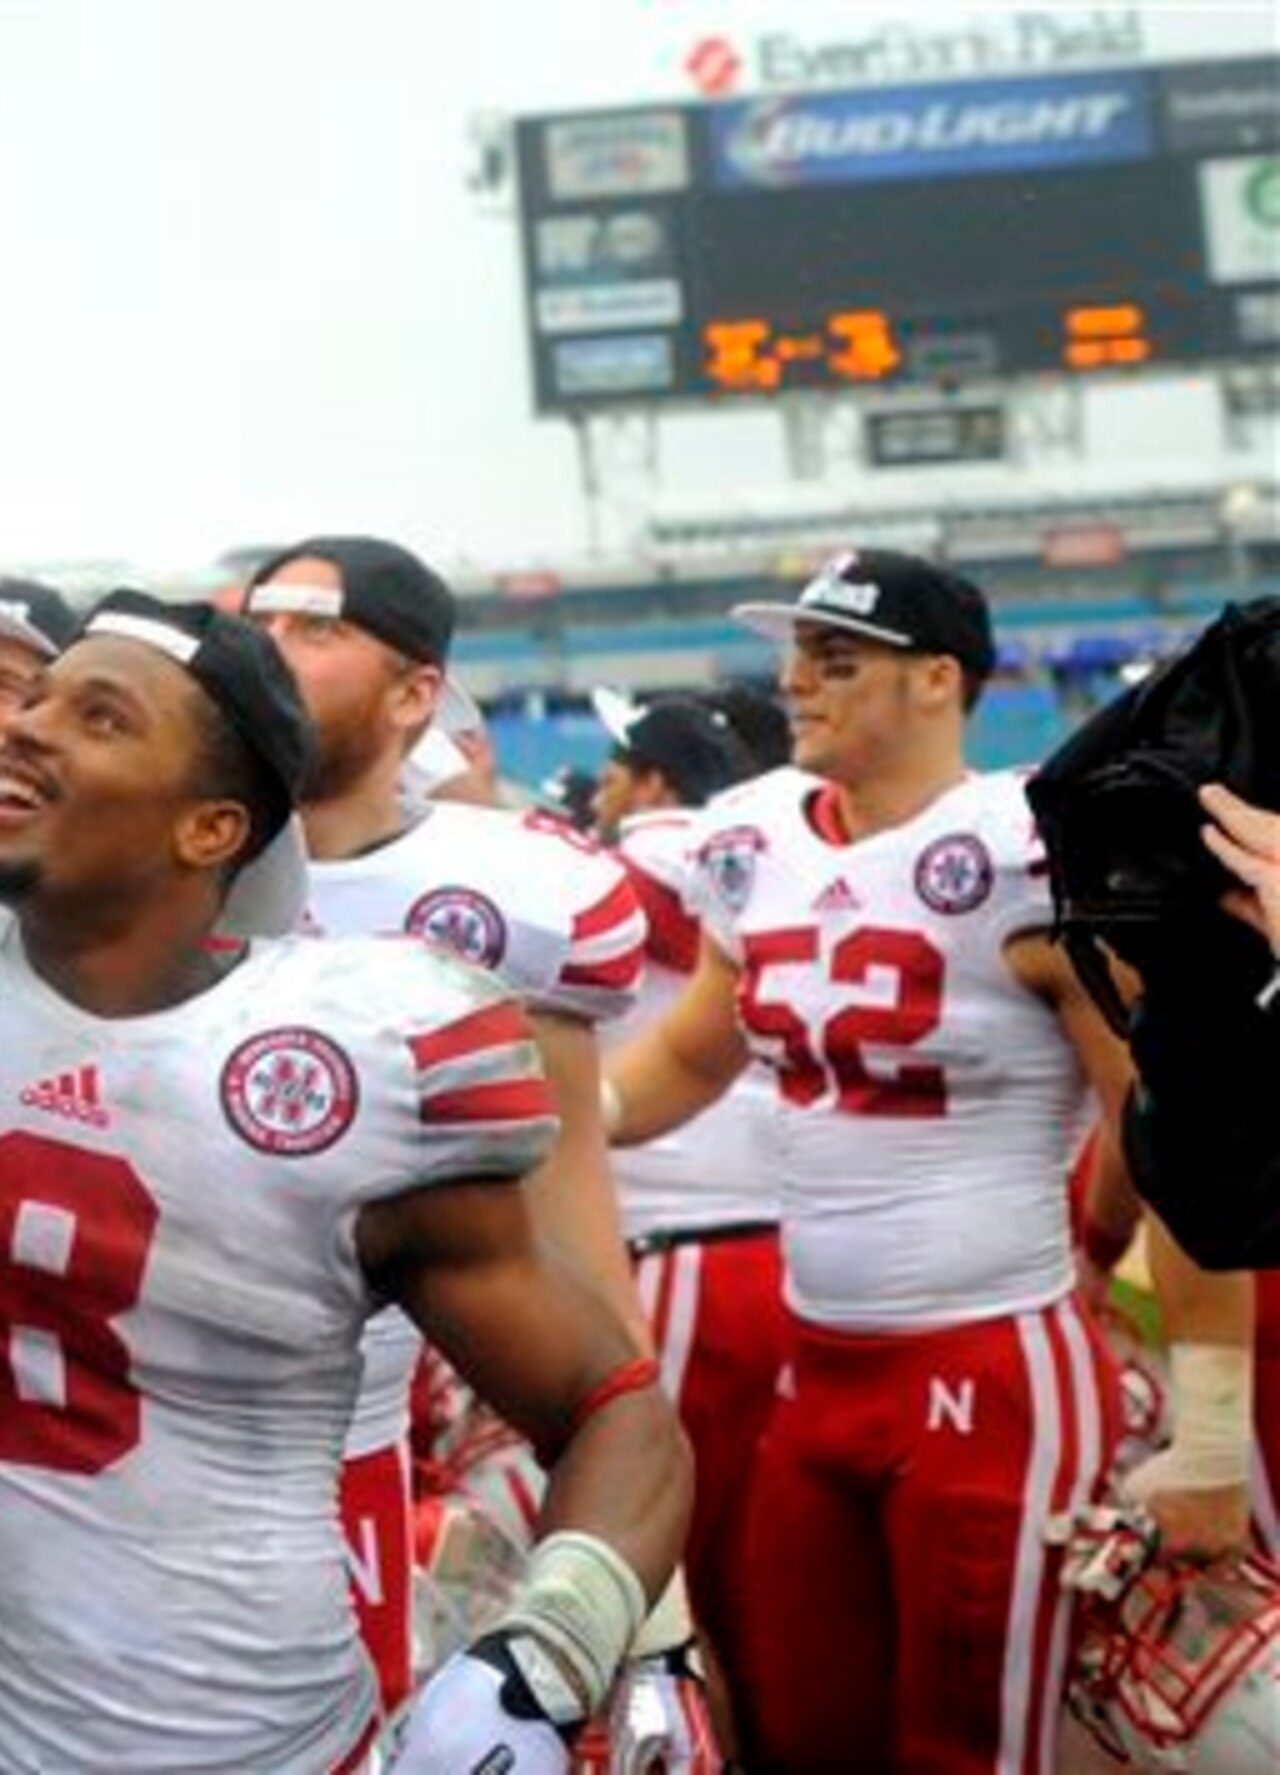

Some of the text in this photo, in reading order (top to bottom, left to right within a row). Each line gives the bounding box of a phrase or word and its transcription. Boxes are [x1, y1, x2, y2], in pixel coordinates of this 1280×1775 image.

[763, 110, 911, 158] BUD
[920, 95, 1129, 150] LIGHT
[738, 926, 946, 1117] 52
[927, 1378, 975, 1435] N
